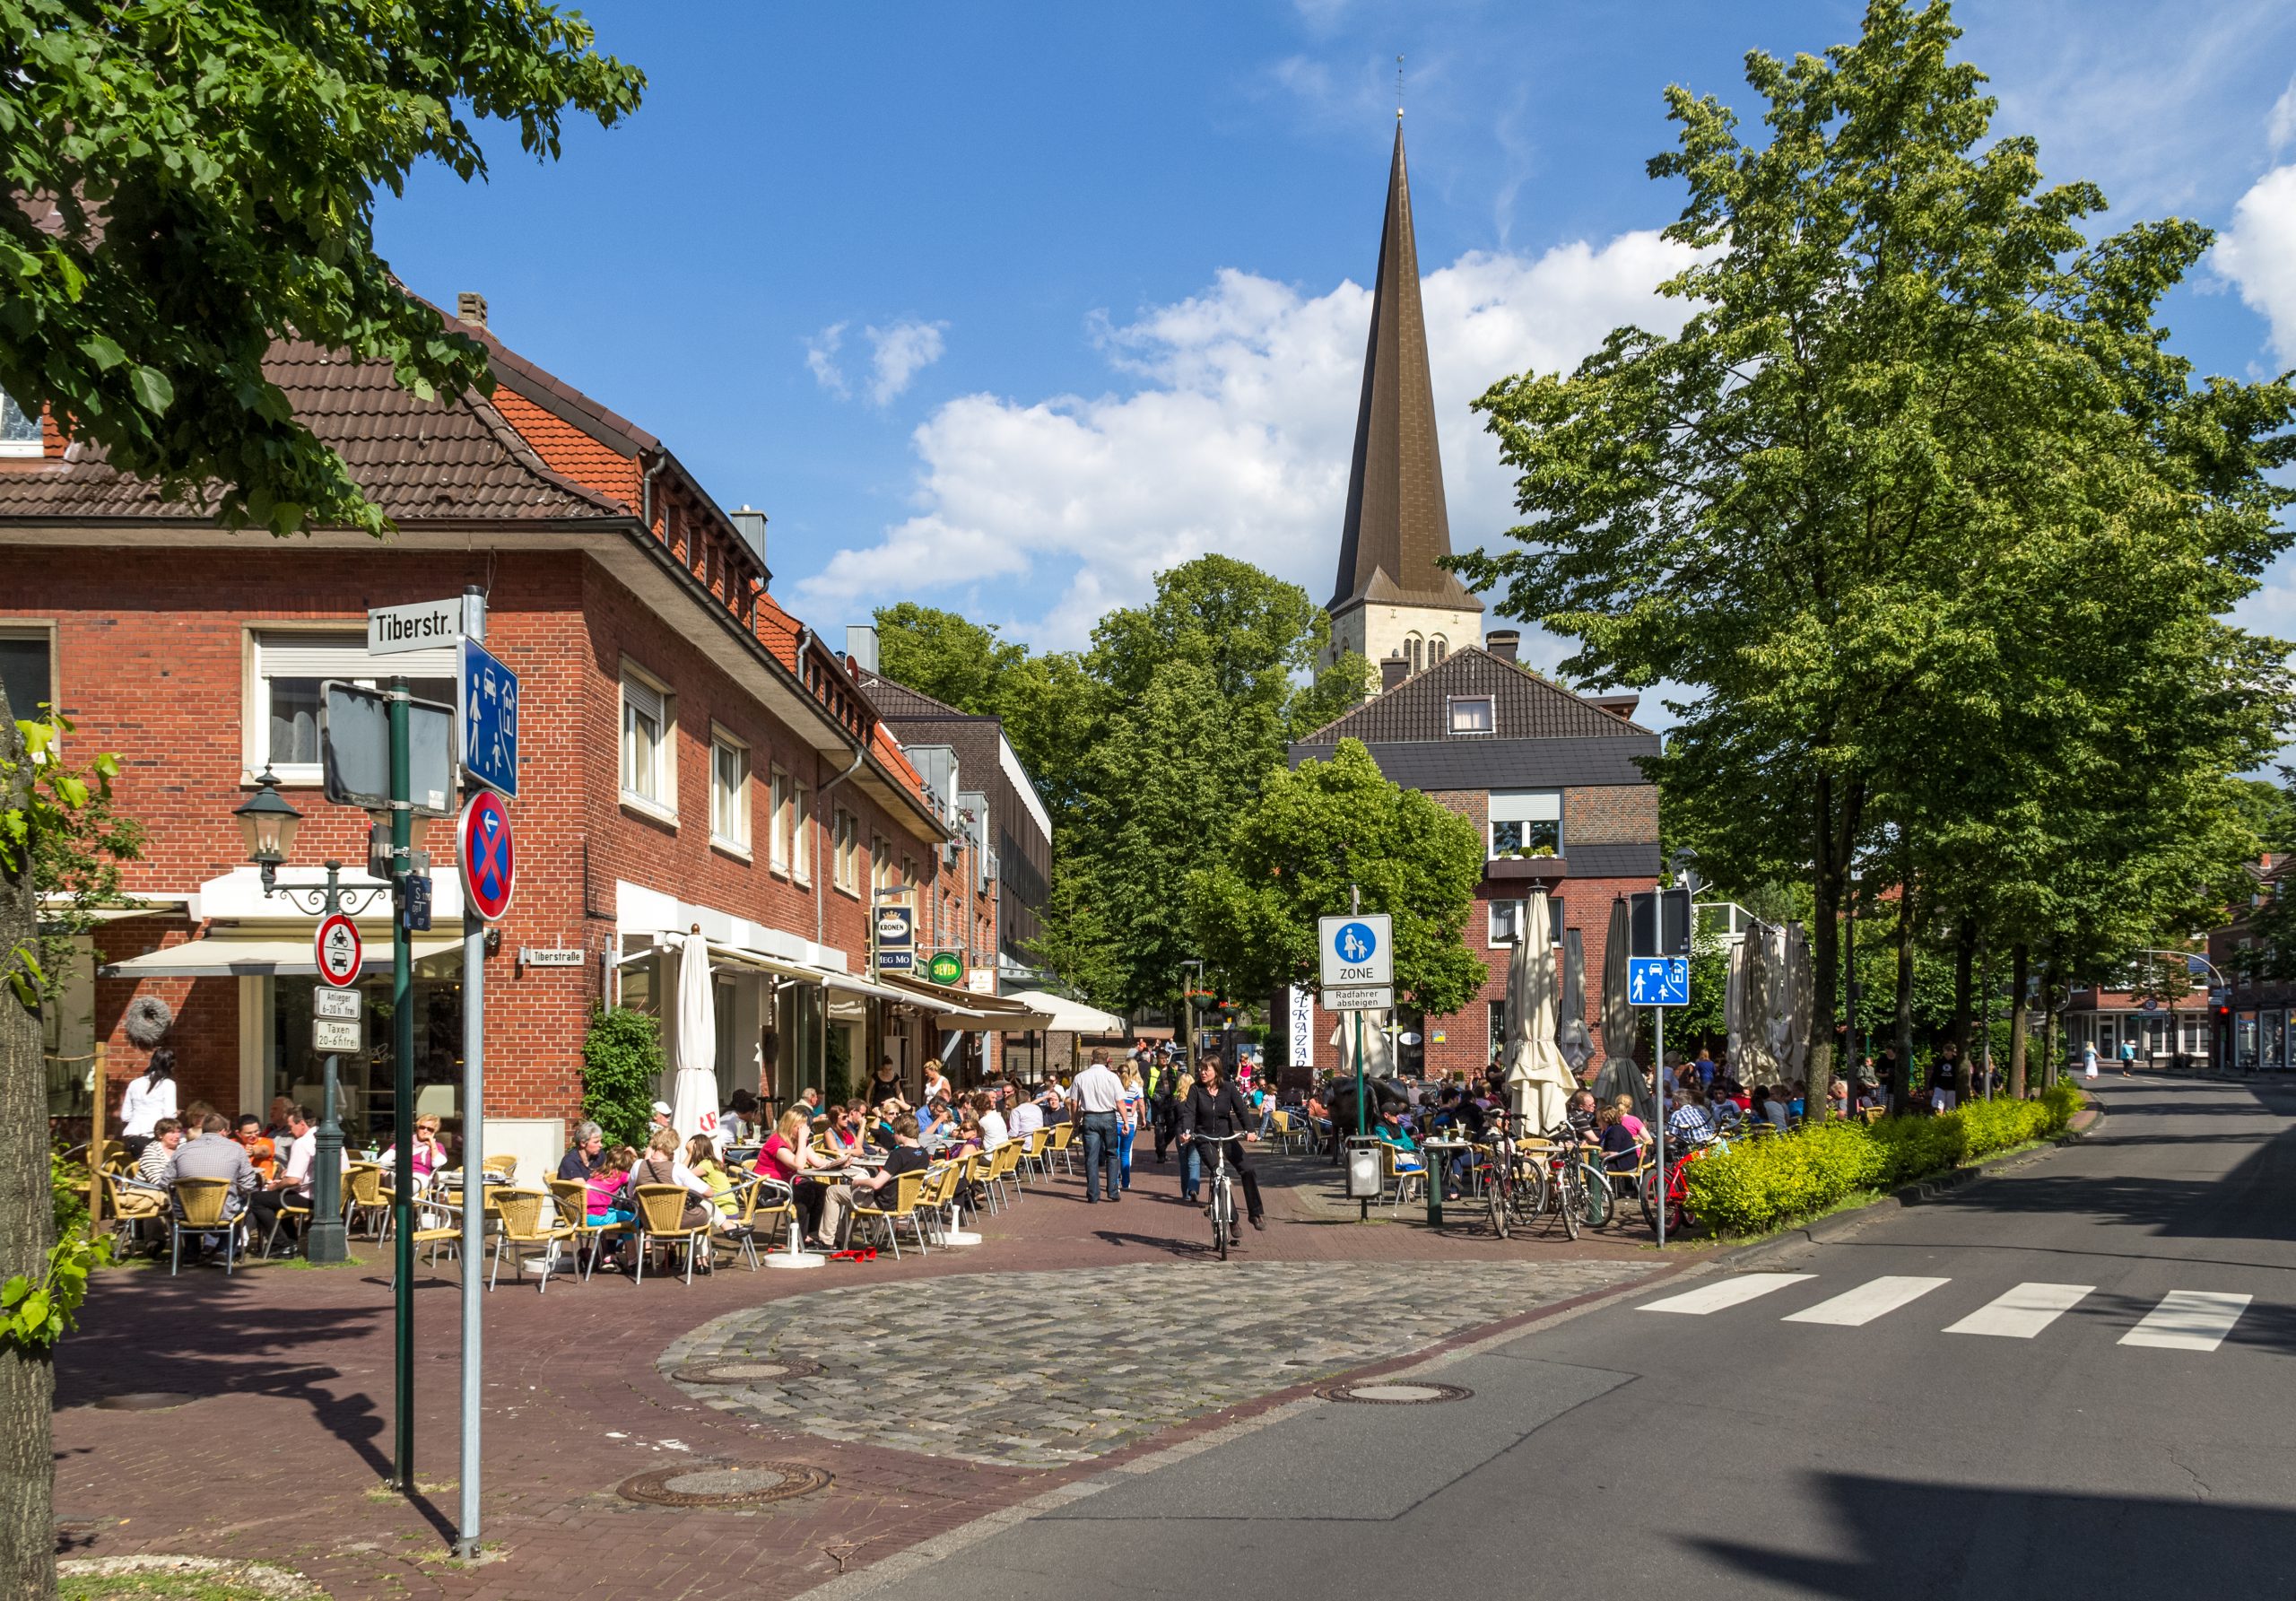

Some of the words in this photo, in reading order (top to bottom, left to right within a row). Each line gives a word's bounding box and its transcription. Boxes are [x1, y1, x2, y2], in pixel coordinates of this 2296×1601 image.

[376, 611, 452, 641] Tiberstr.
[534, 951, 580, 961] Tiberstraße
[934, 962, 957, 976] JEVER
[1339, 968, 1374, 979] ZONE
[326, 991, 352, 1004] Anlieger
[1335, 990, 1378, 999] Radfahrer
[1336, 999, 1378, 1008] absteigen
[344, 1005, 355, 1015] frei
[326, 1023, 350, 1034] Taxen
[344, 1037, 357, 1047] frei
